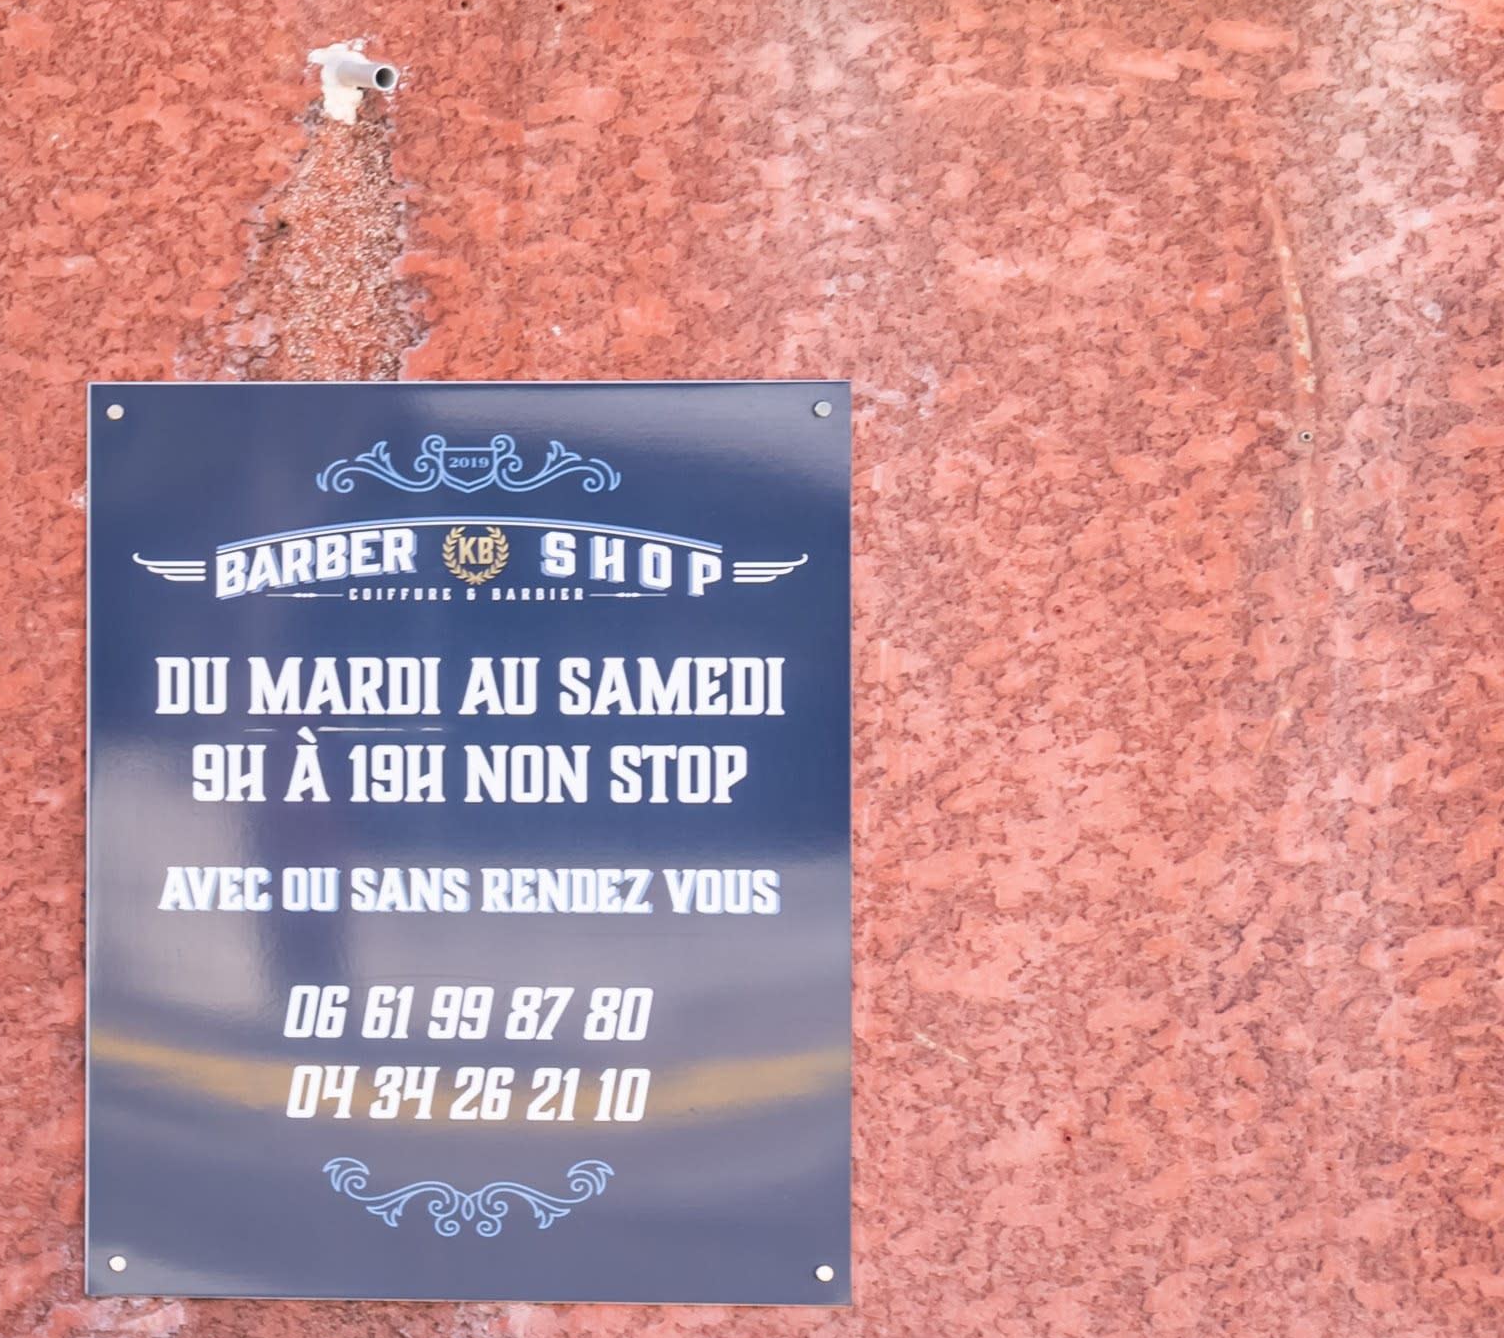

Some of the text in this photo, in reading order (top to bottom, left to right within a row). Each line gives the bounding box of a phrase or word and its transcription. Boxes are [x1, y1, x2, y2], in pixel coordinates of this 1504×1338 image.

[448, 456, 490, 469] 2019
[215, 527, 723, 600] BARBER KB SHOP
[348, 587, 585, 602] COIFFURE & BARBIER
[155, 656, 786, 716] DU MARDI AU SAMEDI
[191, 726, 748, 804] 9H À 19H NON STOP
[158, 866, 781, 916] AVEC OU SANS RENDEZ VOUS
[283, 984, 654, 1041] 06 61 99 87 80
[286, 1065, 652, 1123] 04 34 26 21 10
